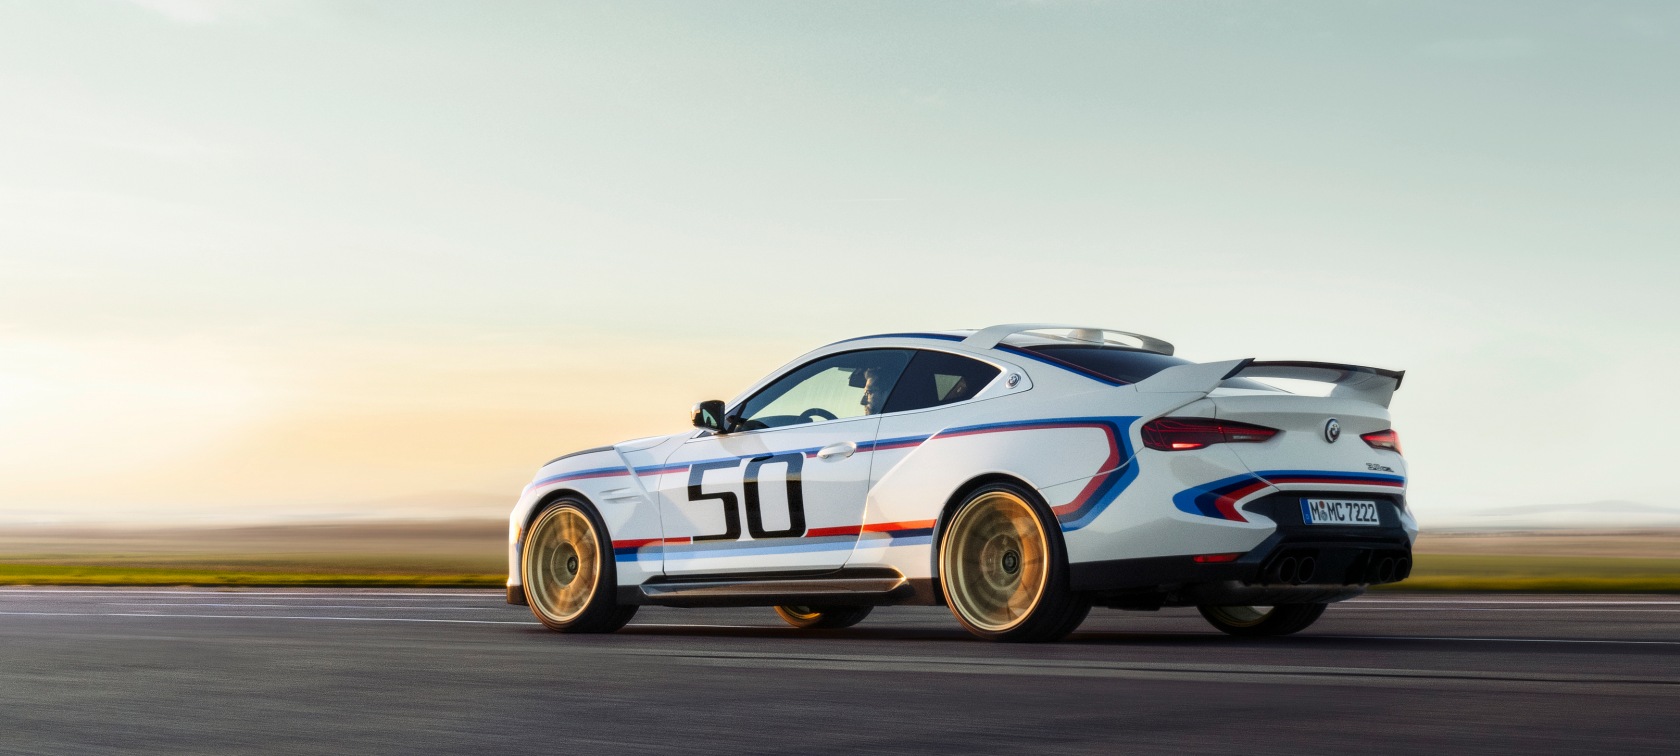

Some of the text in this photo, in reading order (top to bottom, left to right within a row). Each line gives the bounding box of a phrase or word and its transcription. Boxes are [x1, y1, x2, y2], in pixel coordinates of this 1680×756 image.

[687, 452, 806, 540] 50
[1310, 502, 1377, 522] M MC 7222
